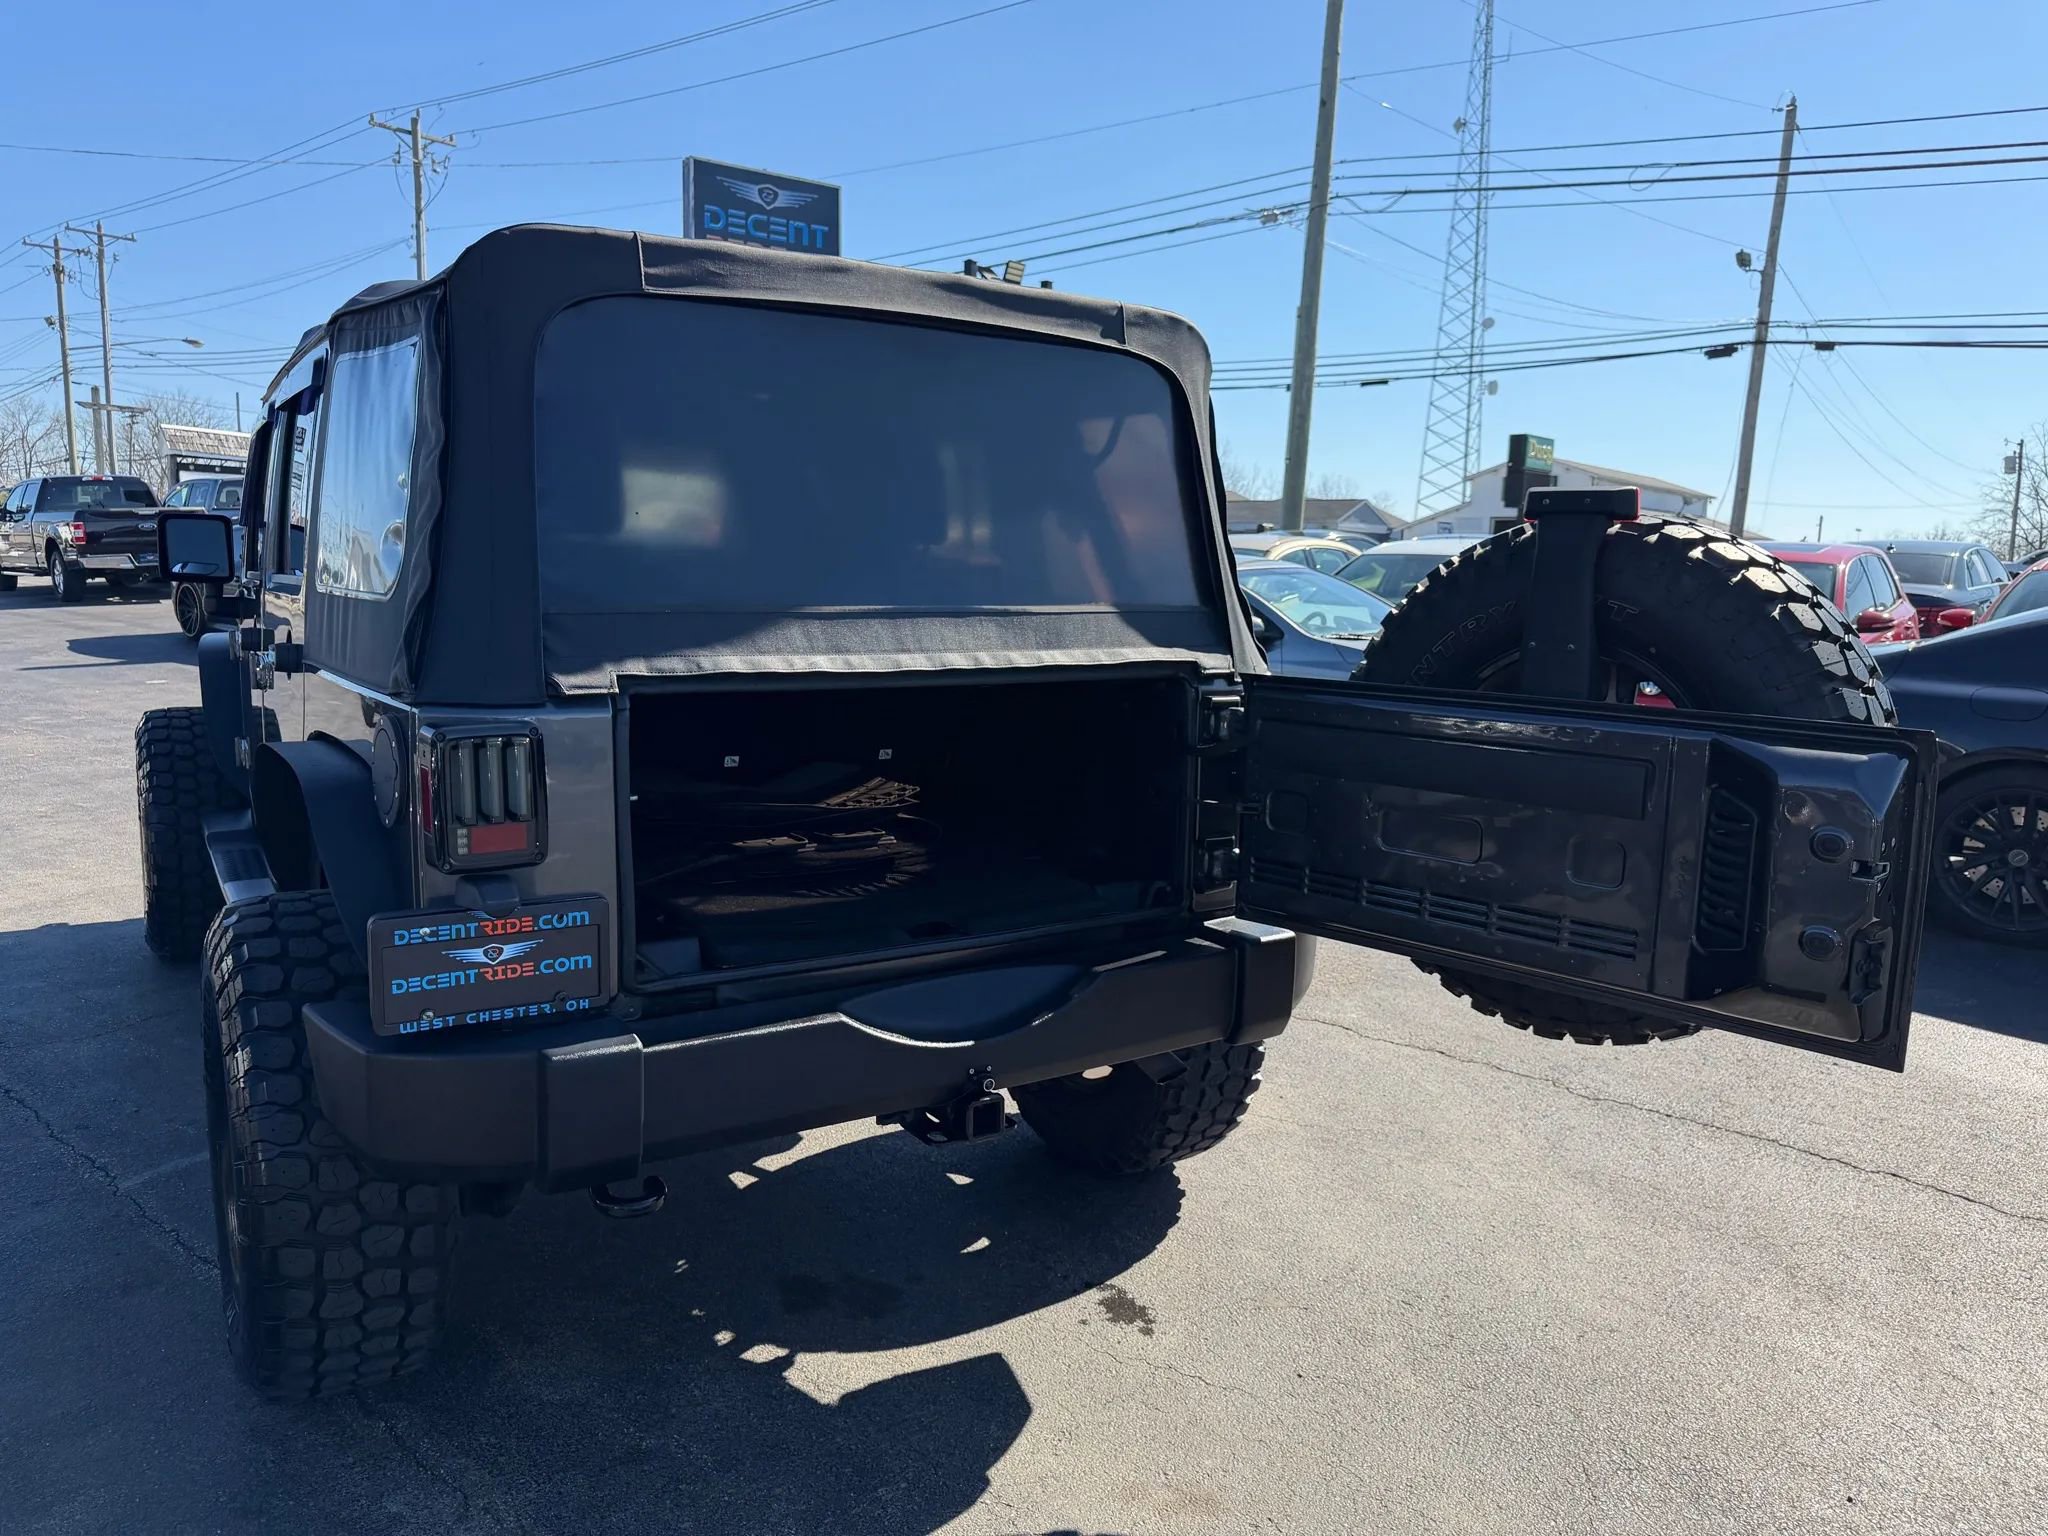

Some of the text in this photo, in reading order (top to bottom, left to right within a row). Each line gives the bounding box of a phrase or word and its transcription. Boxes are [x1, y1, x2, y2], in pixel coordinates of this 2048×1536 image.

[704, 204, 829, 249] DECENT
[400, 1015, 456, 1034] WEST
[565, 999, 589, 1012] OH
